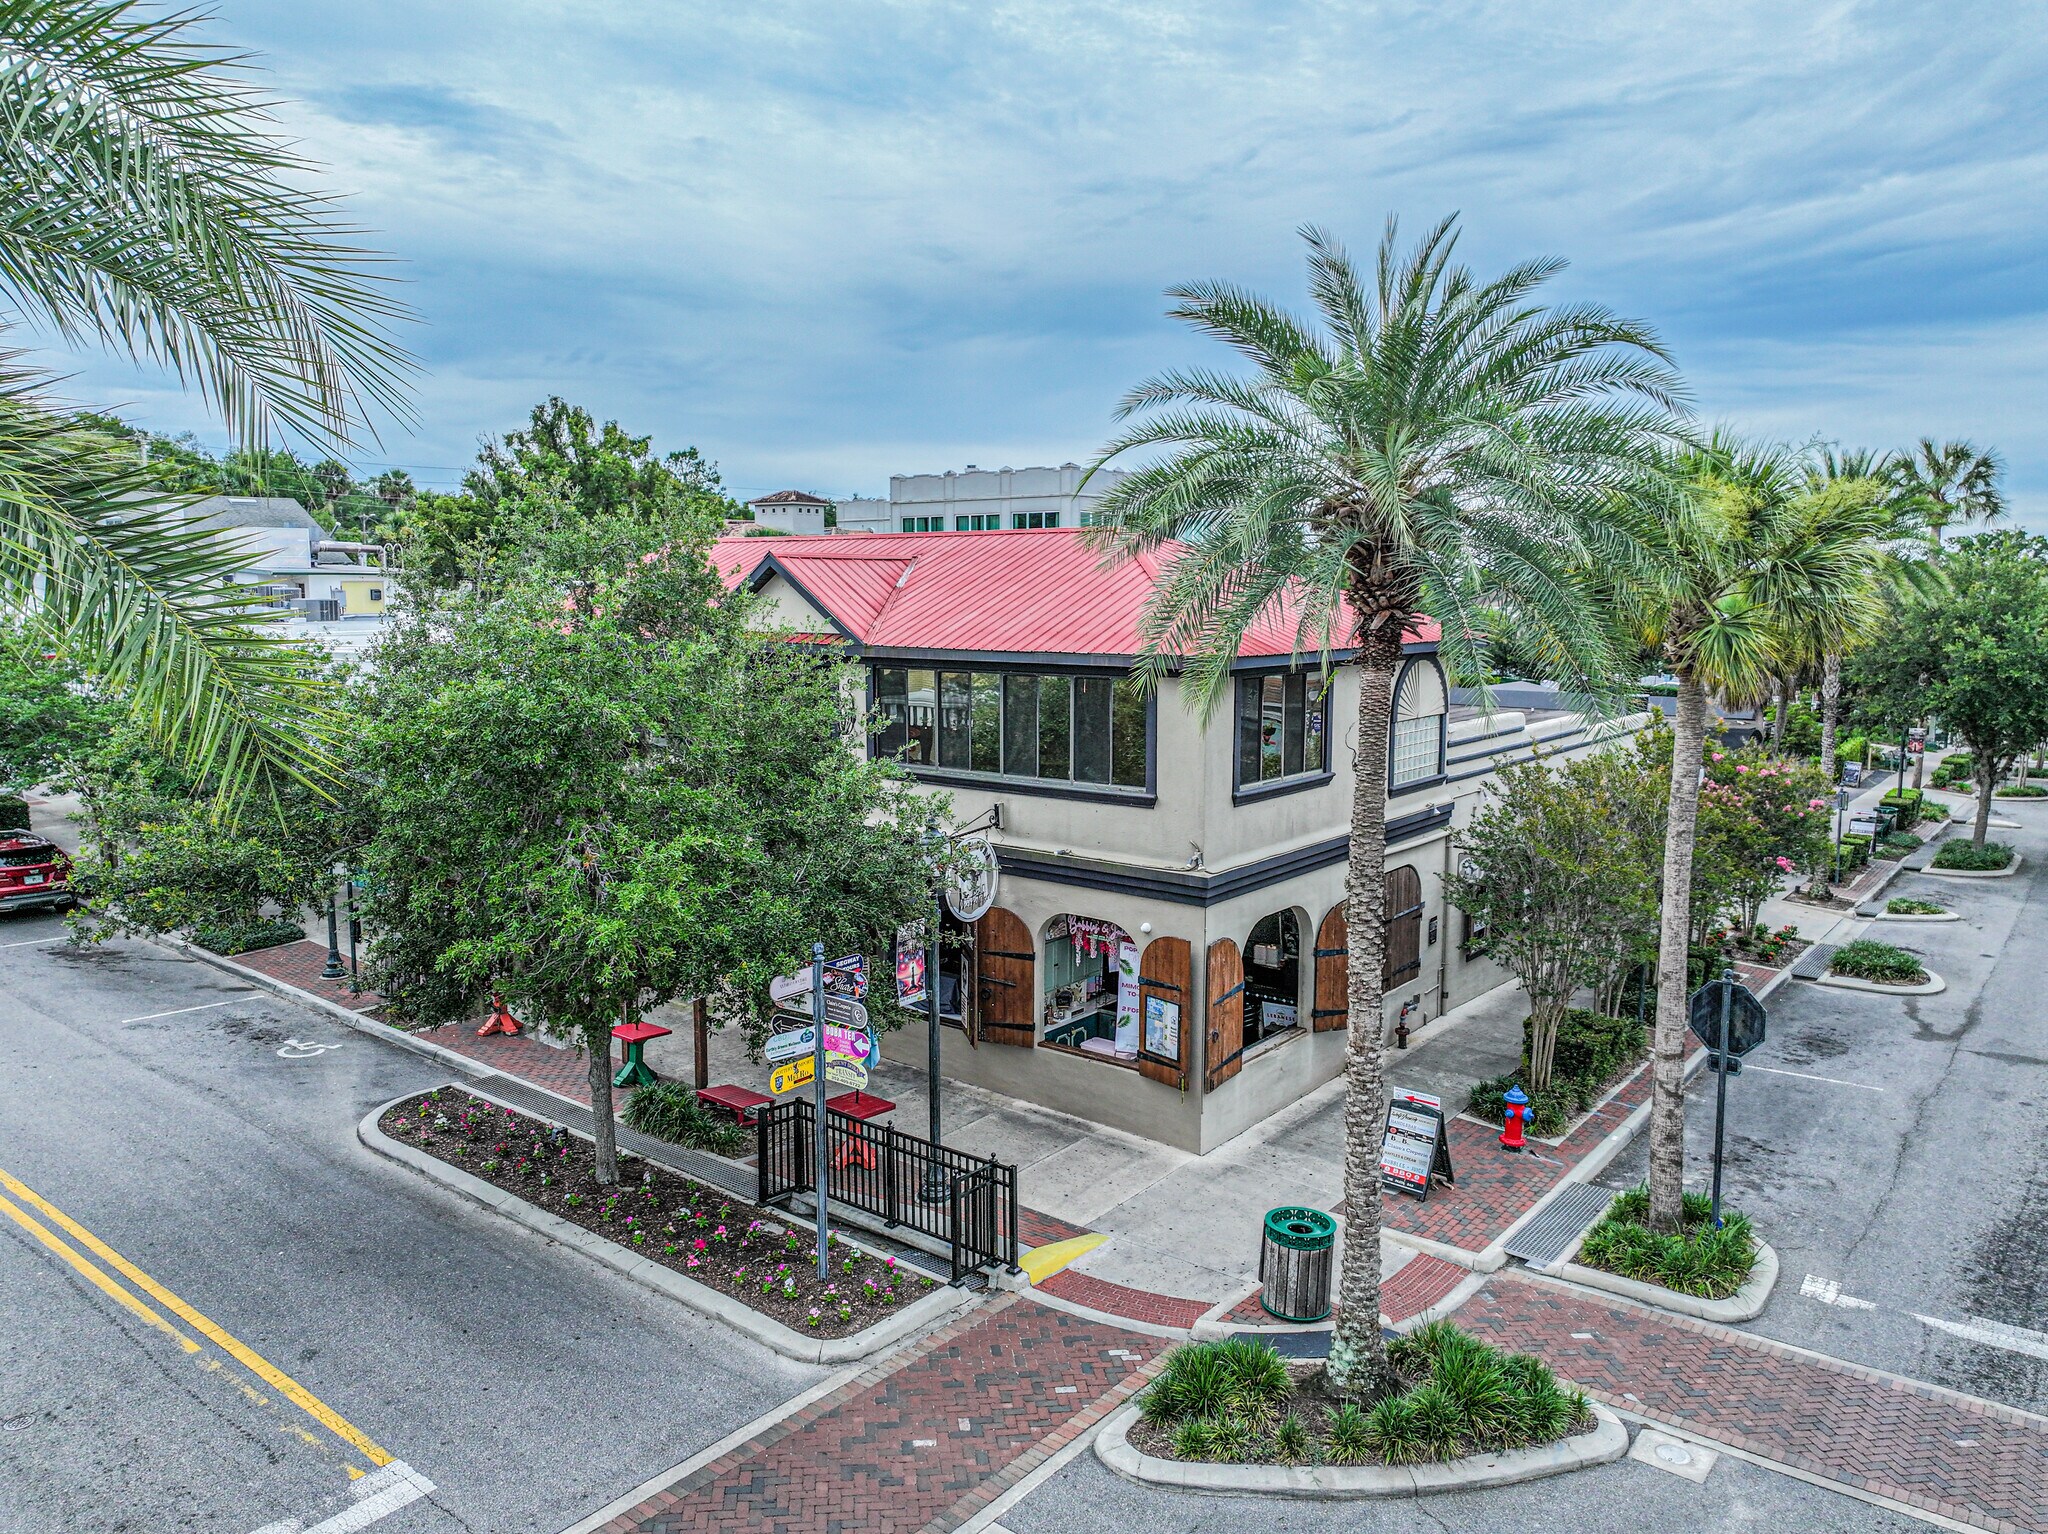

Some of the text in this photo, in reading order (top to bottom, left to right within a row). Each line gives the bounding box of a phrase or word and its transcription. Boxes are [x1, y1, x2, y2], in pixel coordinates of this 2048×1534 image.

[836, 956, 860, 968] SEGWAY
[1266, 1012, 1295, 1022] LEBANESE
[825, 1026, 843, 1039] BOBA
[843, 1030, 856, 1042] TEA
